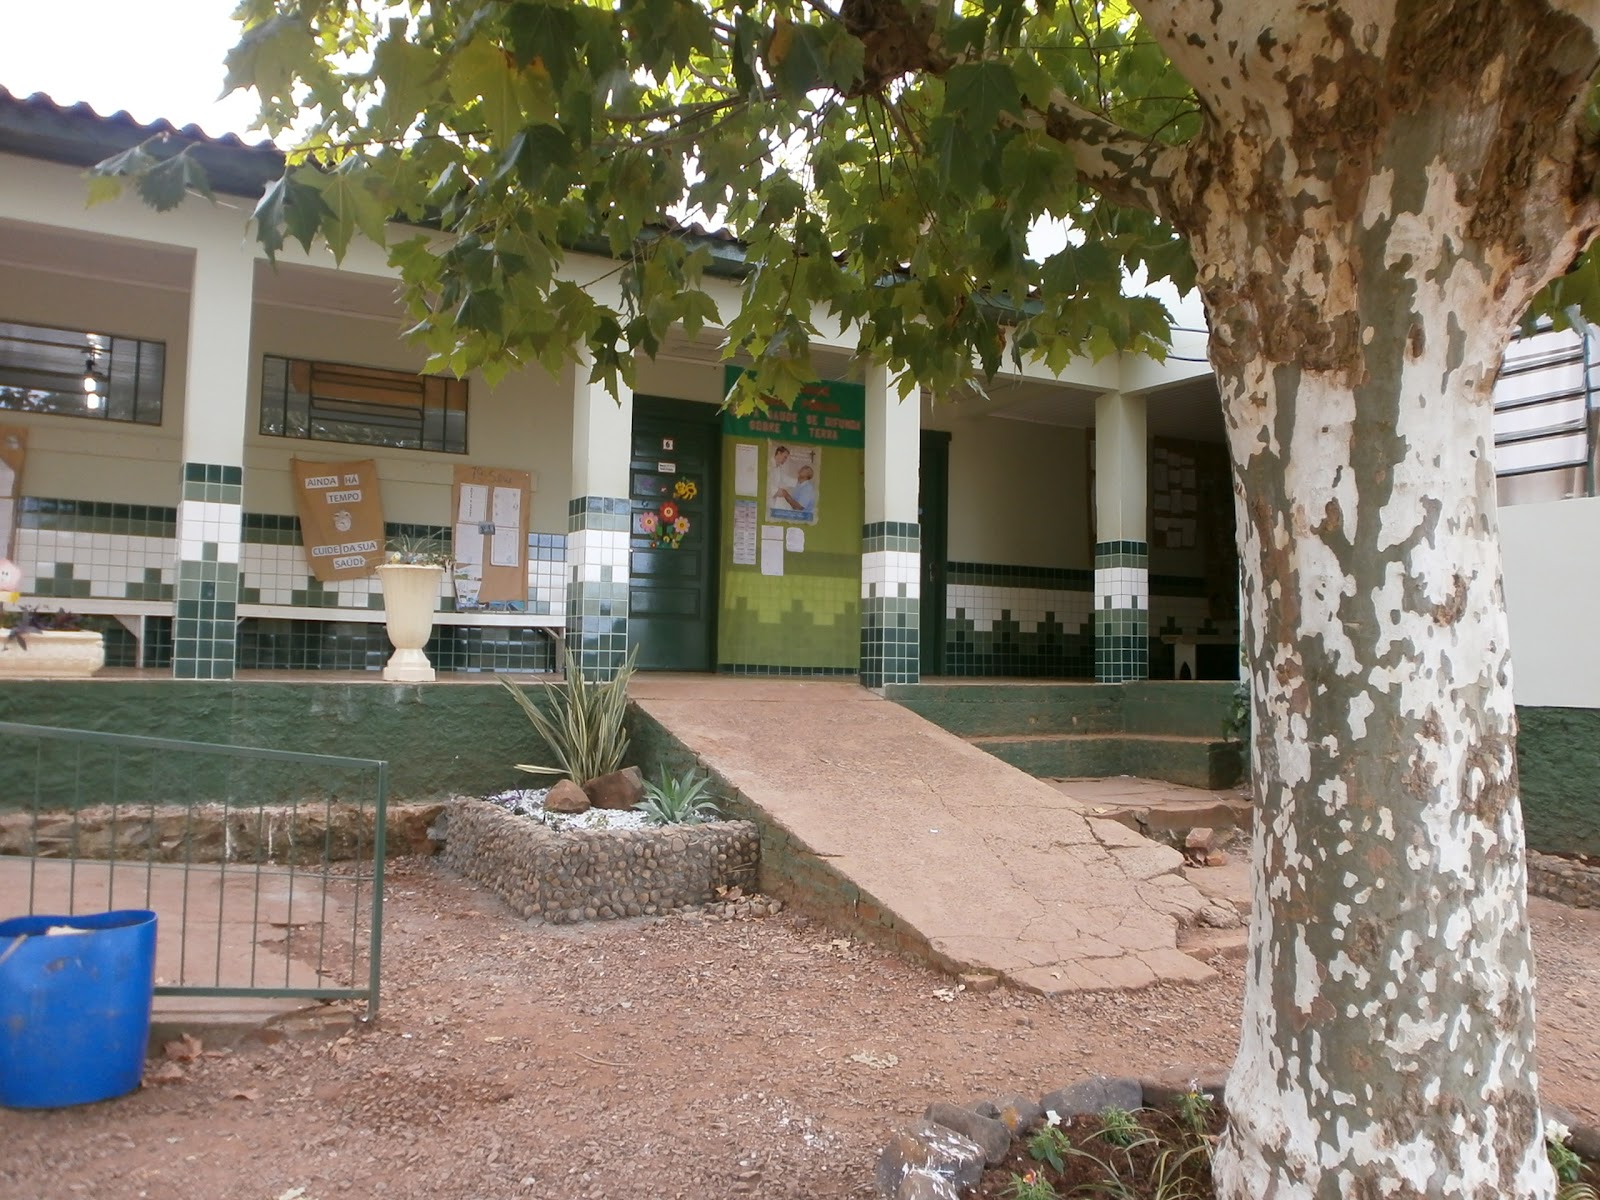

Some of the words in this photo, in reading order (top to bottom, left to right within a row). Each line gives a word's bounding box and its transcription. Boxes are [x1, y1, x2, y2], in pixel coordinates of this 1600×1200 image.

[806, 414, 818, 426] SE
[749, 420, 781, 433] SOBRE
[792, 425, 798, 436] A
[809, 427, 838, 440] TERRA
[307, 477, 337, 487] AINDA
[344, 474, 358, 485] HÁ
[328, 492, 360, 503] TEMPO
[312, 546, 339, 556] CUIDE
[343, 544, 353, 553] DA
[357, 542, 376, 551] SUA
